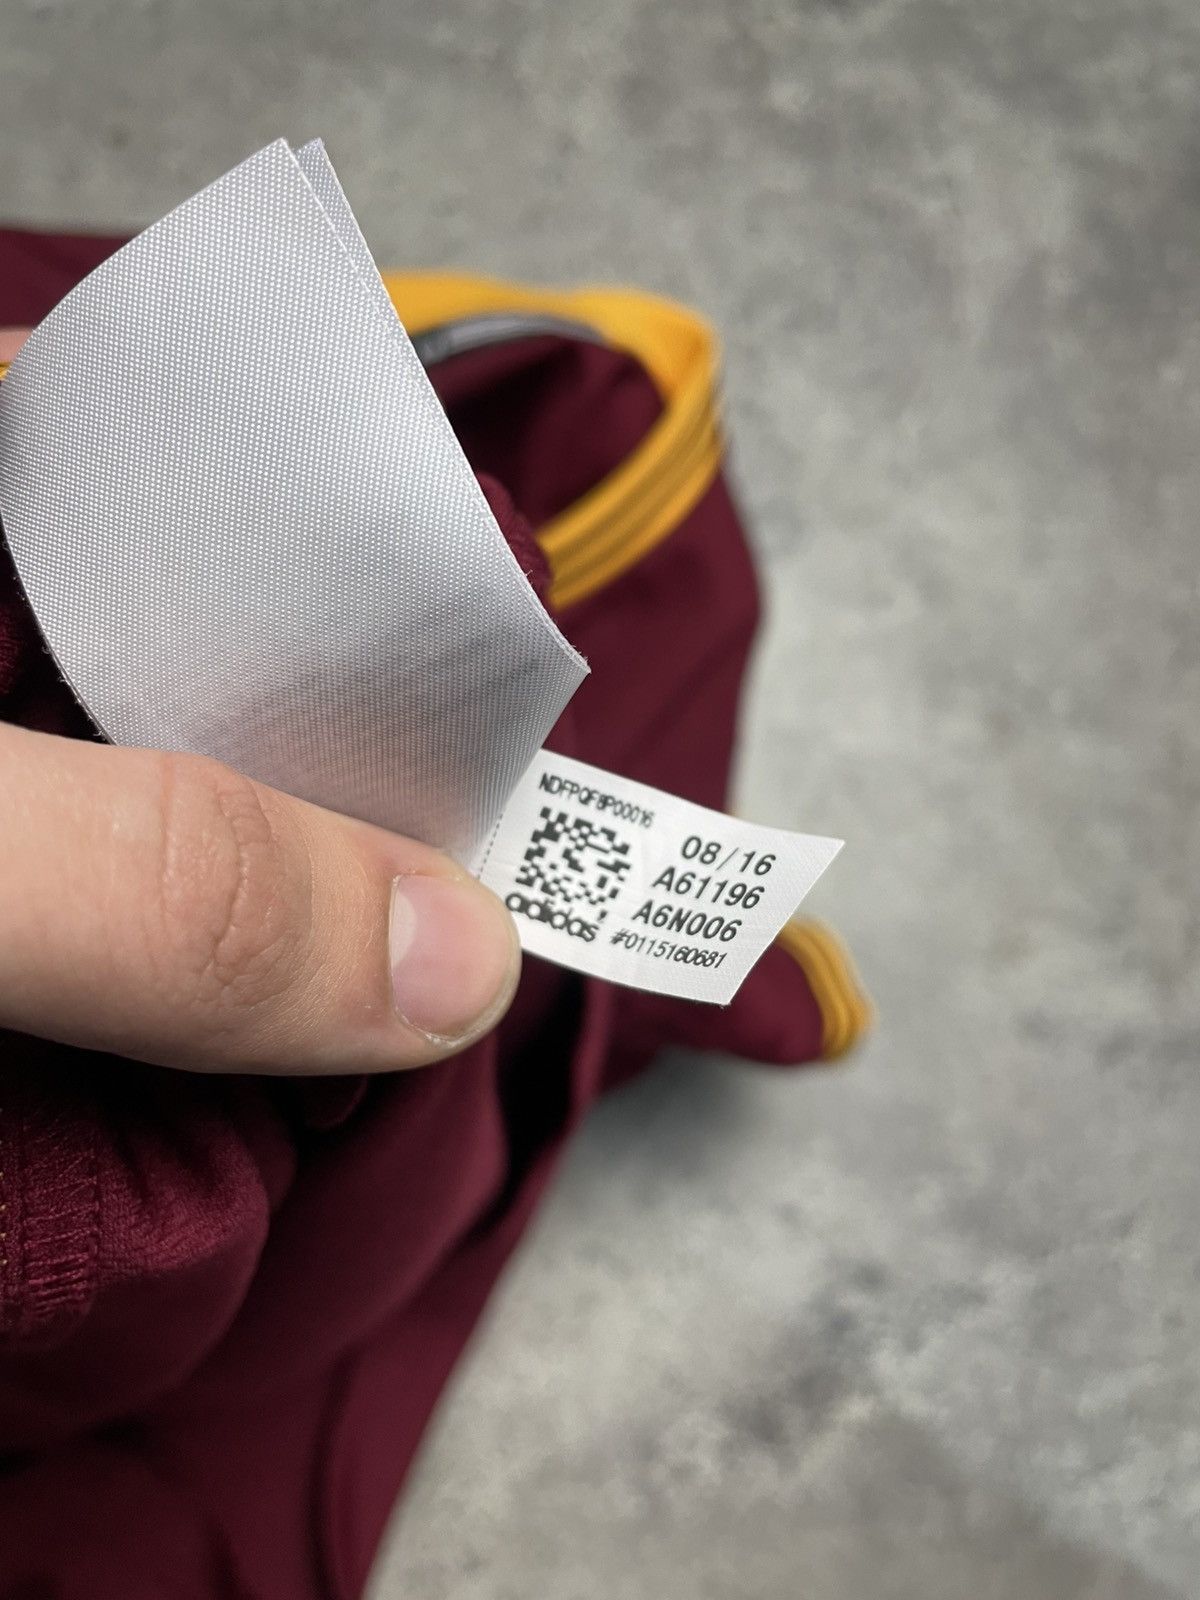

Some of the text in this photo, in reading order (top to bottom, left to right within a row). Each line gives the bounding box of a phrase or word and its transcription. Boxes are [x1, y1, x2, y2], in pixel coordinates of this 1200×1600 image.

[681, 835, 776, 876] 08/16
[651, 866, 765, 909] A61196
[505, 893, 600, 942] adidas
[631, 900, 742, 942] A6N006
[610, 928, 727, 969] #0115160681
